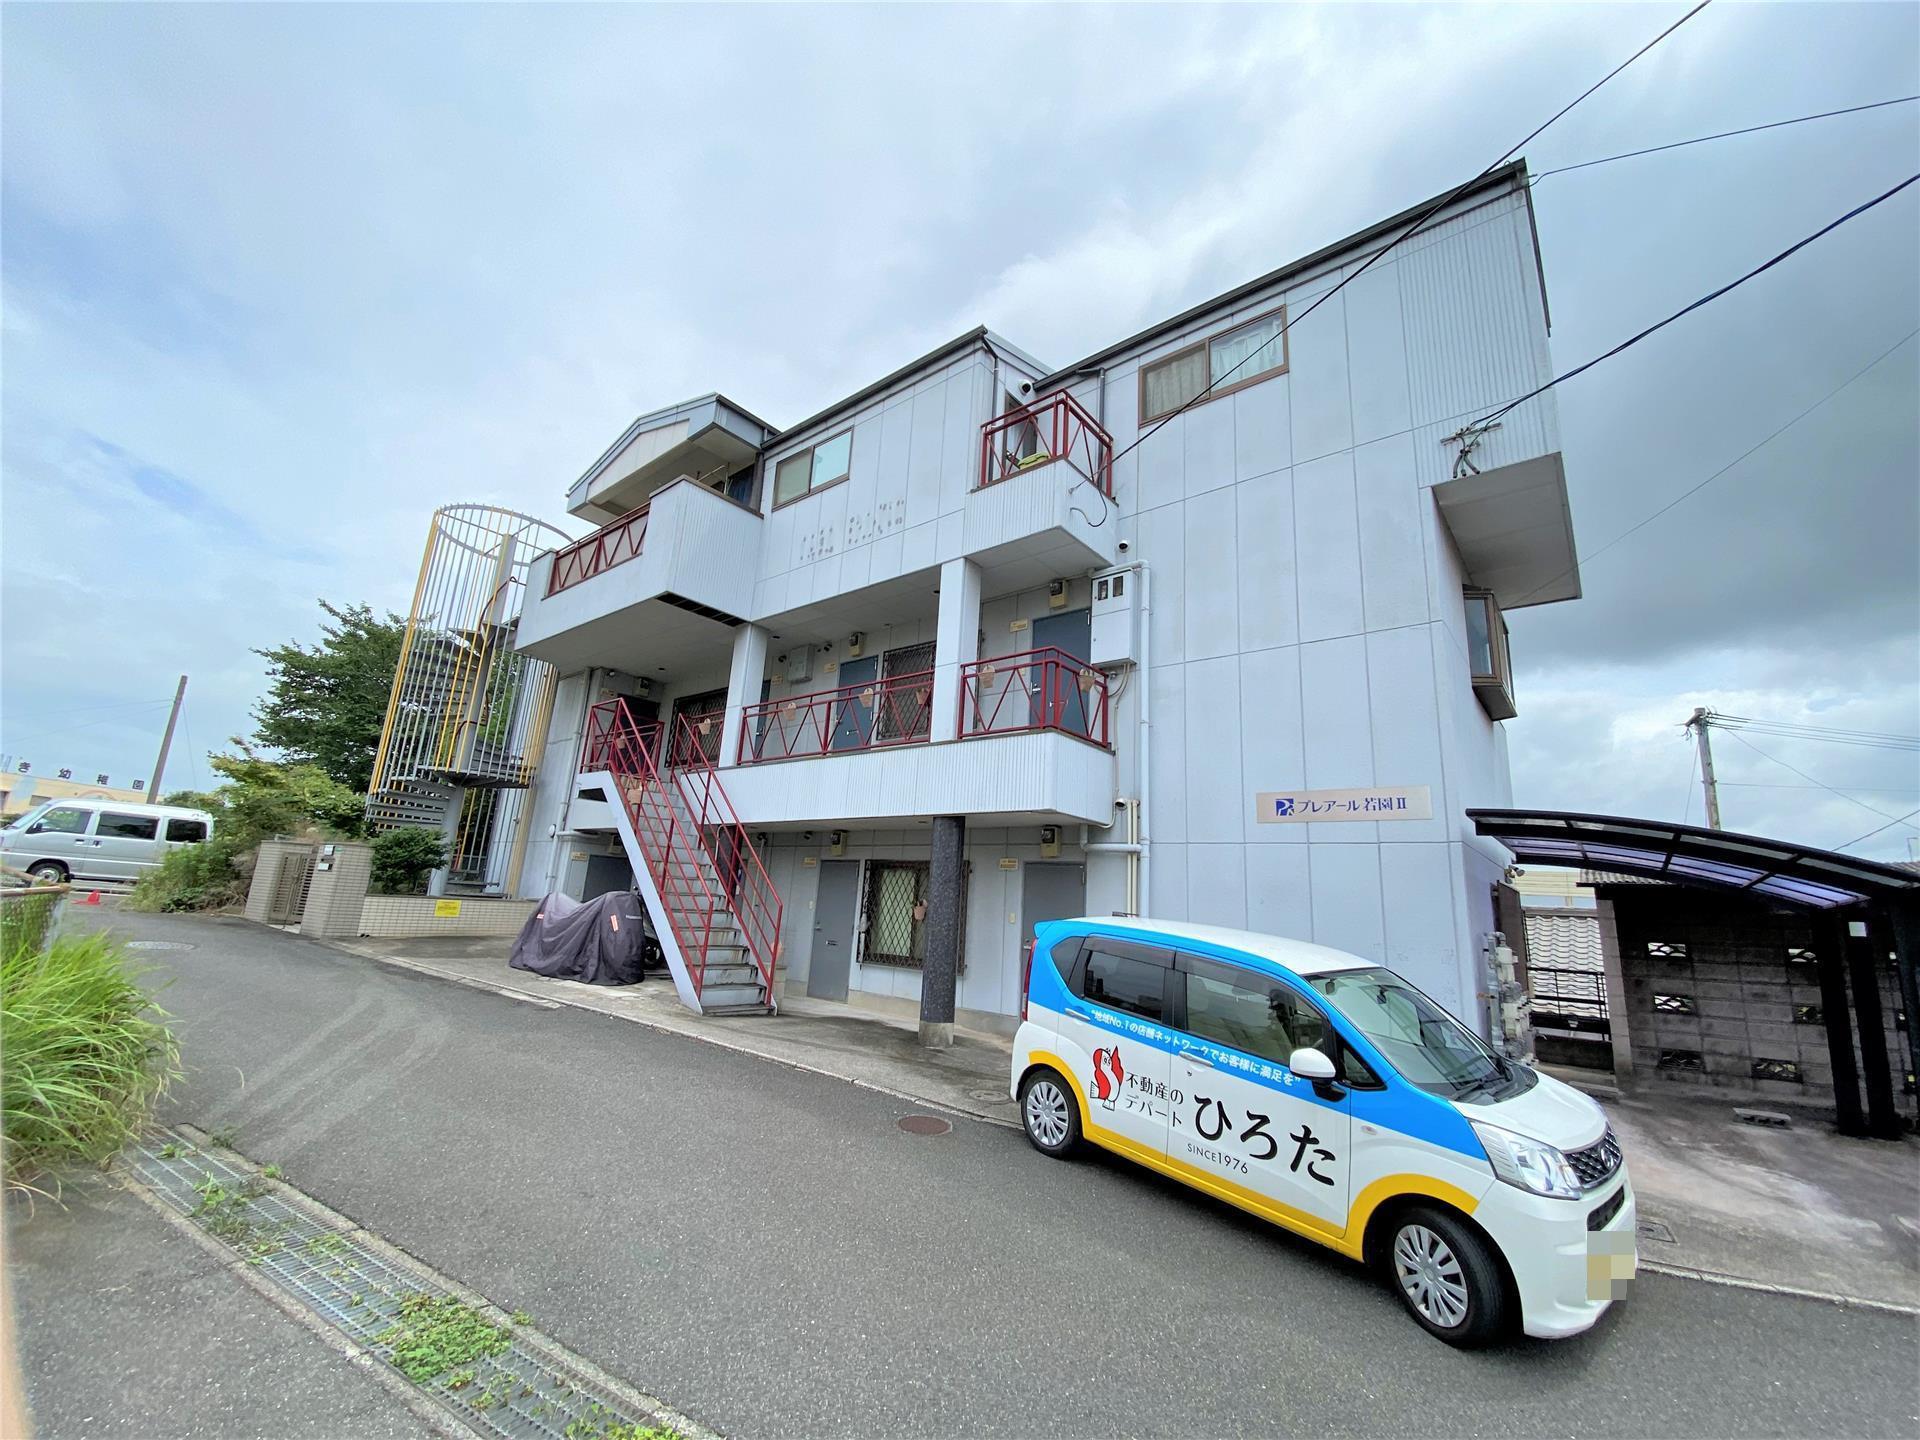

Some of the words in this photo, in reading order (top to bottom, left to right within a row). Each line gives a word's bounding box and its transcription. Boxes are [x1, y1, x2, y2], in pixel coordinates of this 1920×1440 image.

[1126, 1071, 1184, 1105] 不動産の
[1125, 1094, 1183, 1128] デパート
[1193, 1094, 1336, 1187] ひろた
